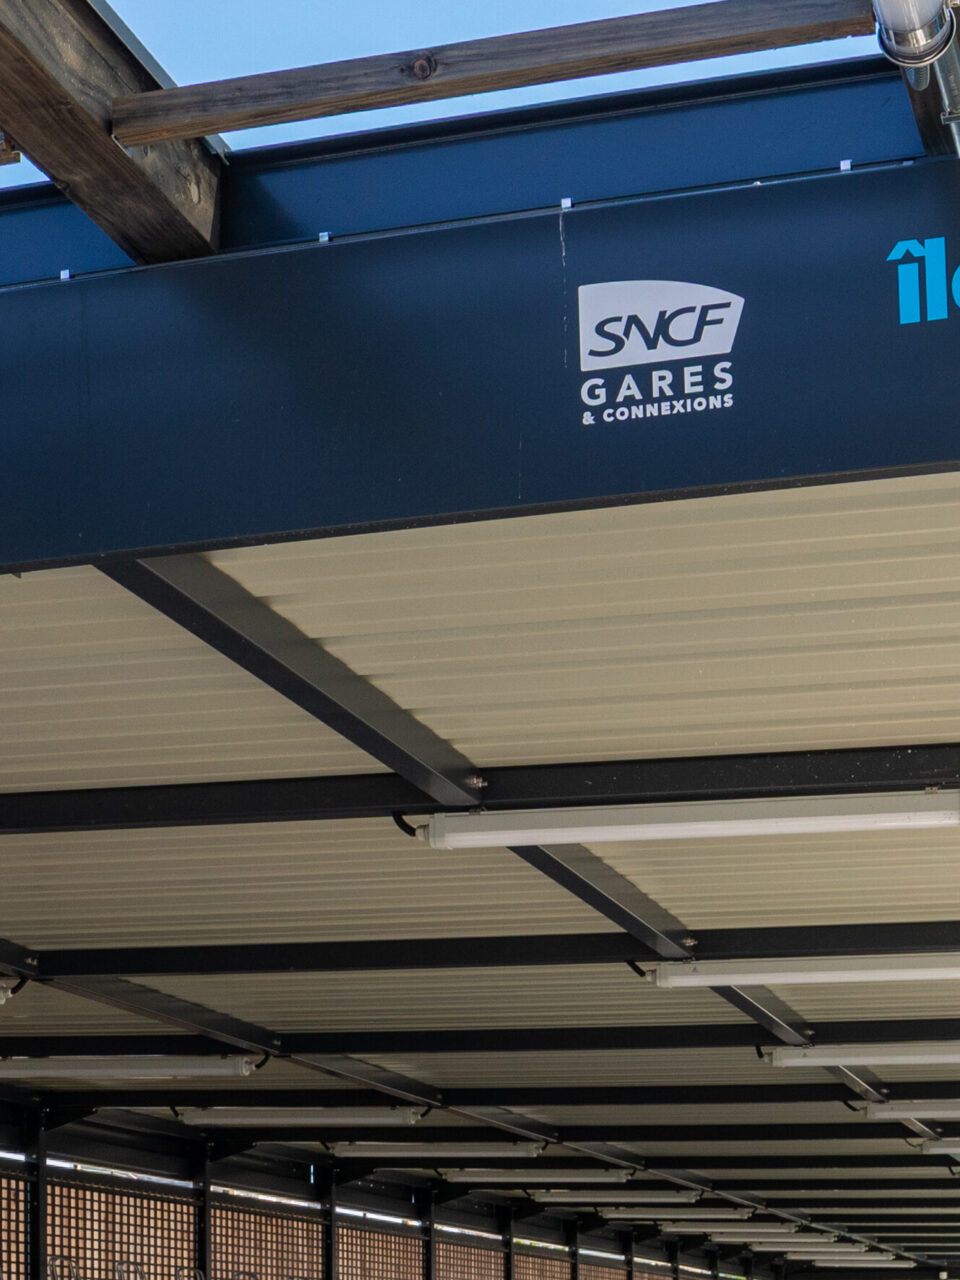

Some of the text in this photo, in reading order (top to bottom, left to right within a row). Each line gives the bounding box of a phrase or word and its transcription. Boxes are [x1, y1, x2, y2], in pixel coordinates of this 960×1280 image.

[588, 301, 732, 357] SNCF
[580, 361, 733, 406] GARES
[582, 393, 734, 425] & CONNEXIONS
